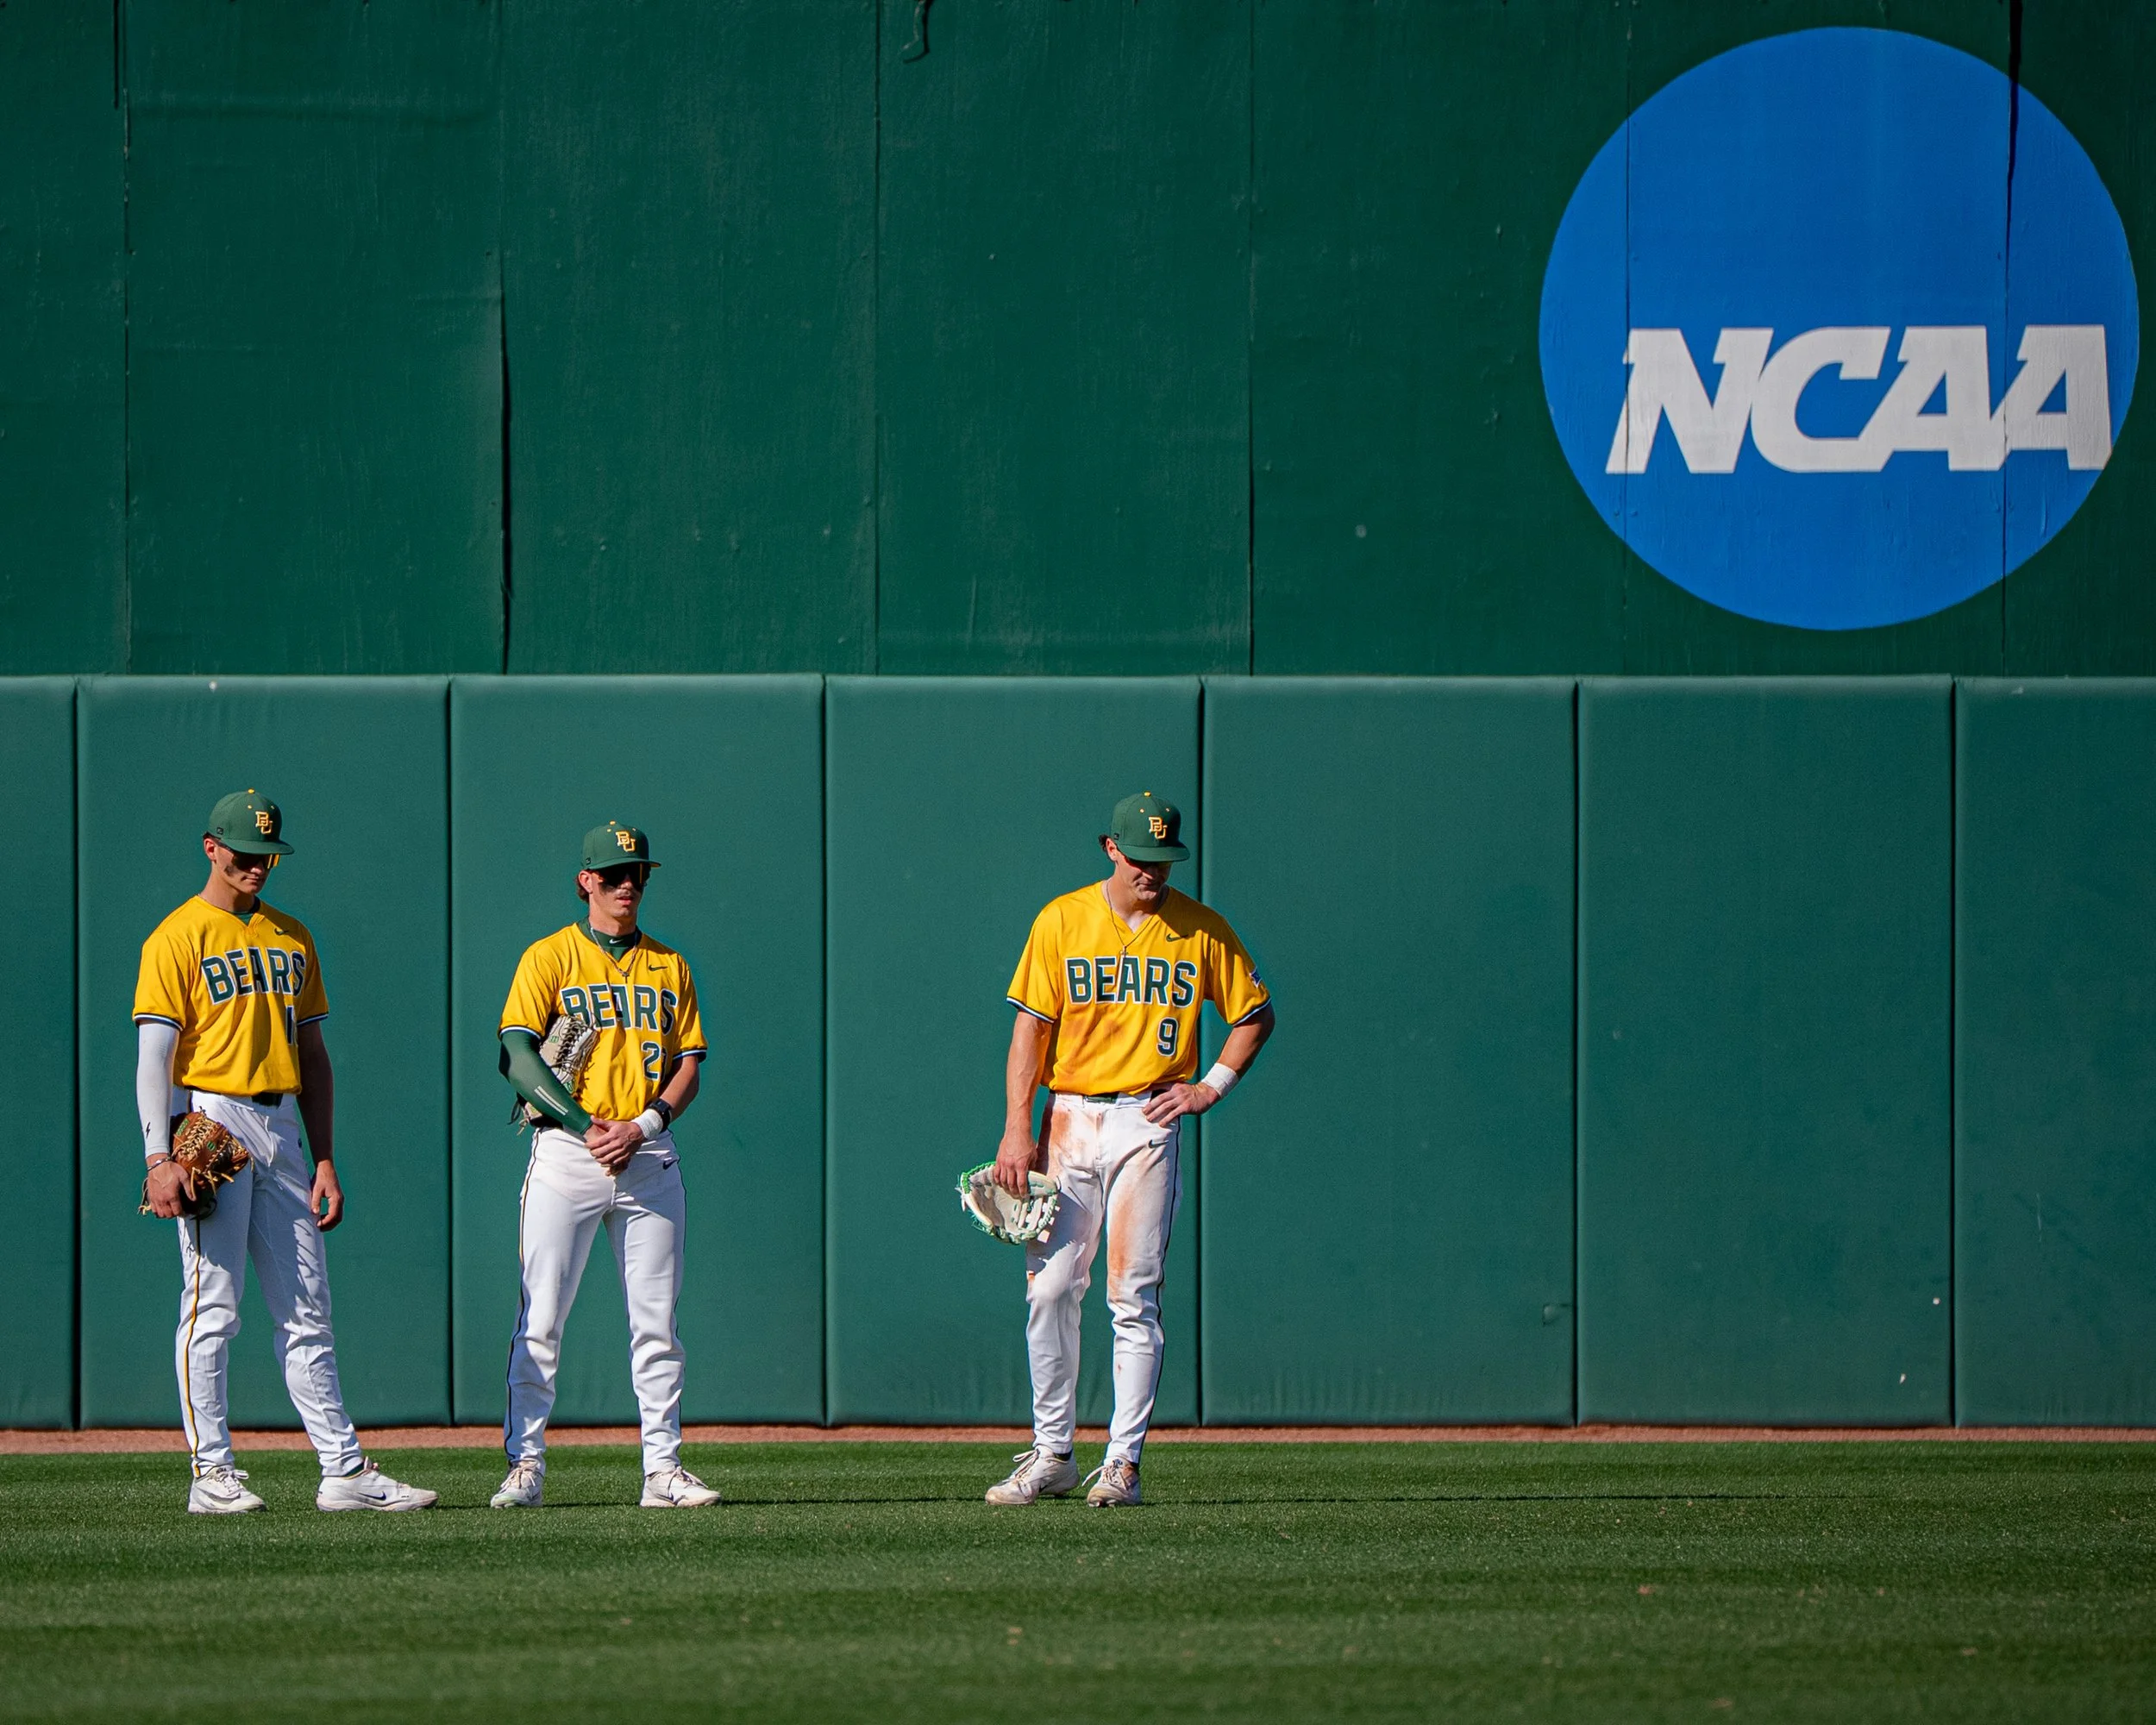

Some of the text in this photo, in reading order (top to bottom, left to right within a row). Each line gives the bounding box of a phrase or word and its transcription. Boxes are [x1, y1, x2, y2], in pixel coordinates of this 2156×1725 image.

[1605, 324, 2113, 474] NCAA
[201, 946, 306, 1006] BEARS
[1064, 955, 1198, 1008] BEARS
[559, 982, 678, 1036] BEARS
[1156, 1017, 1179, 1057] 9
